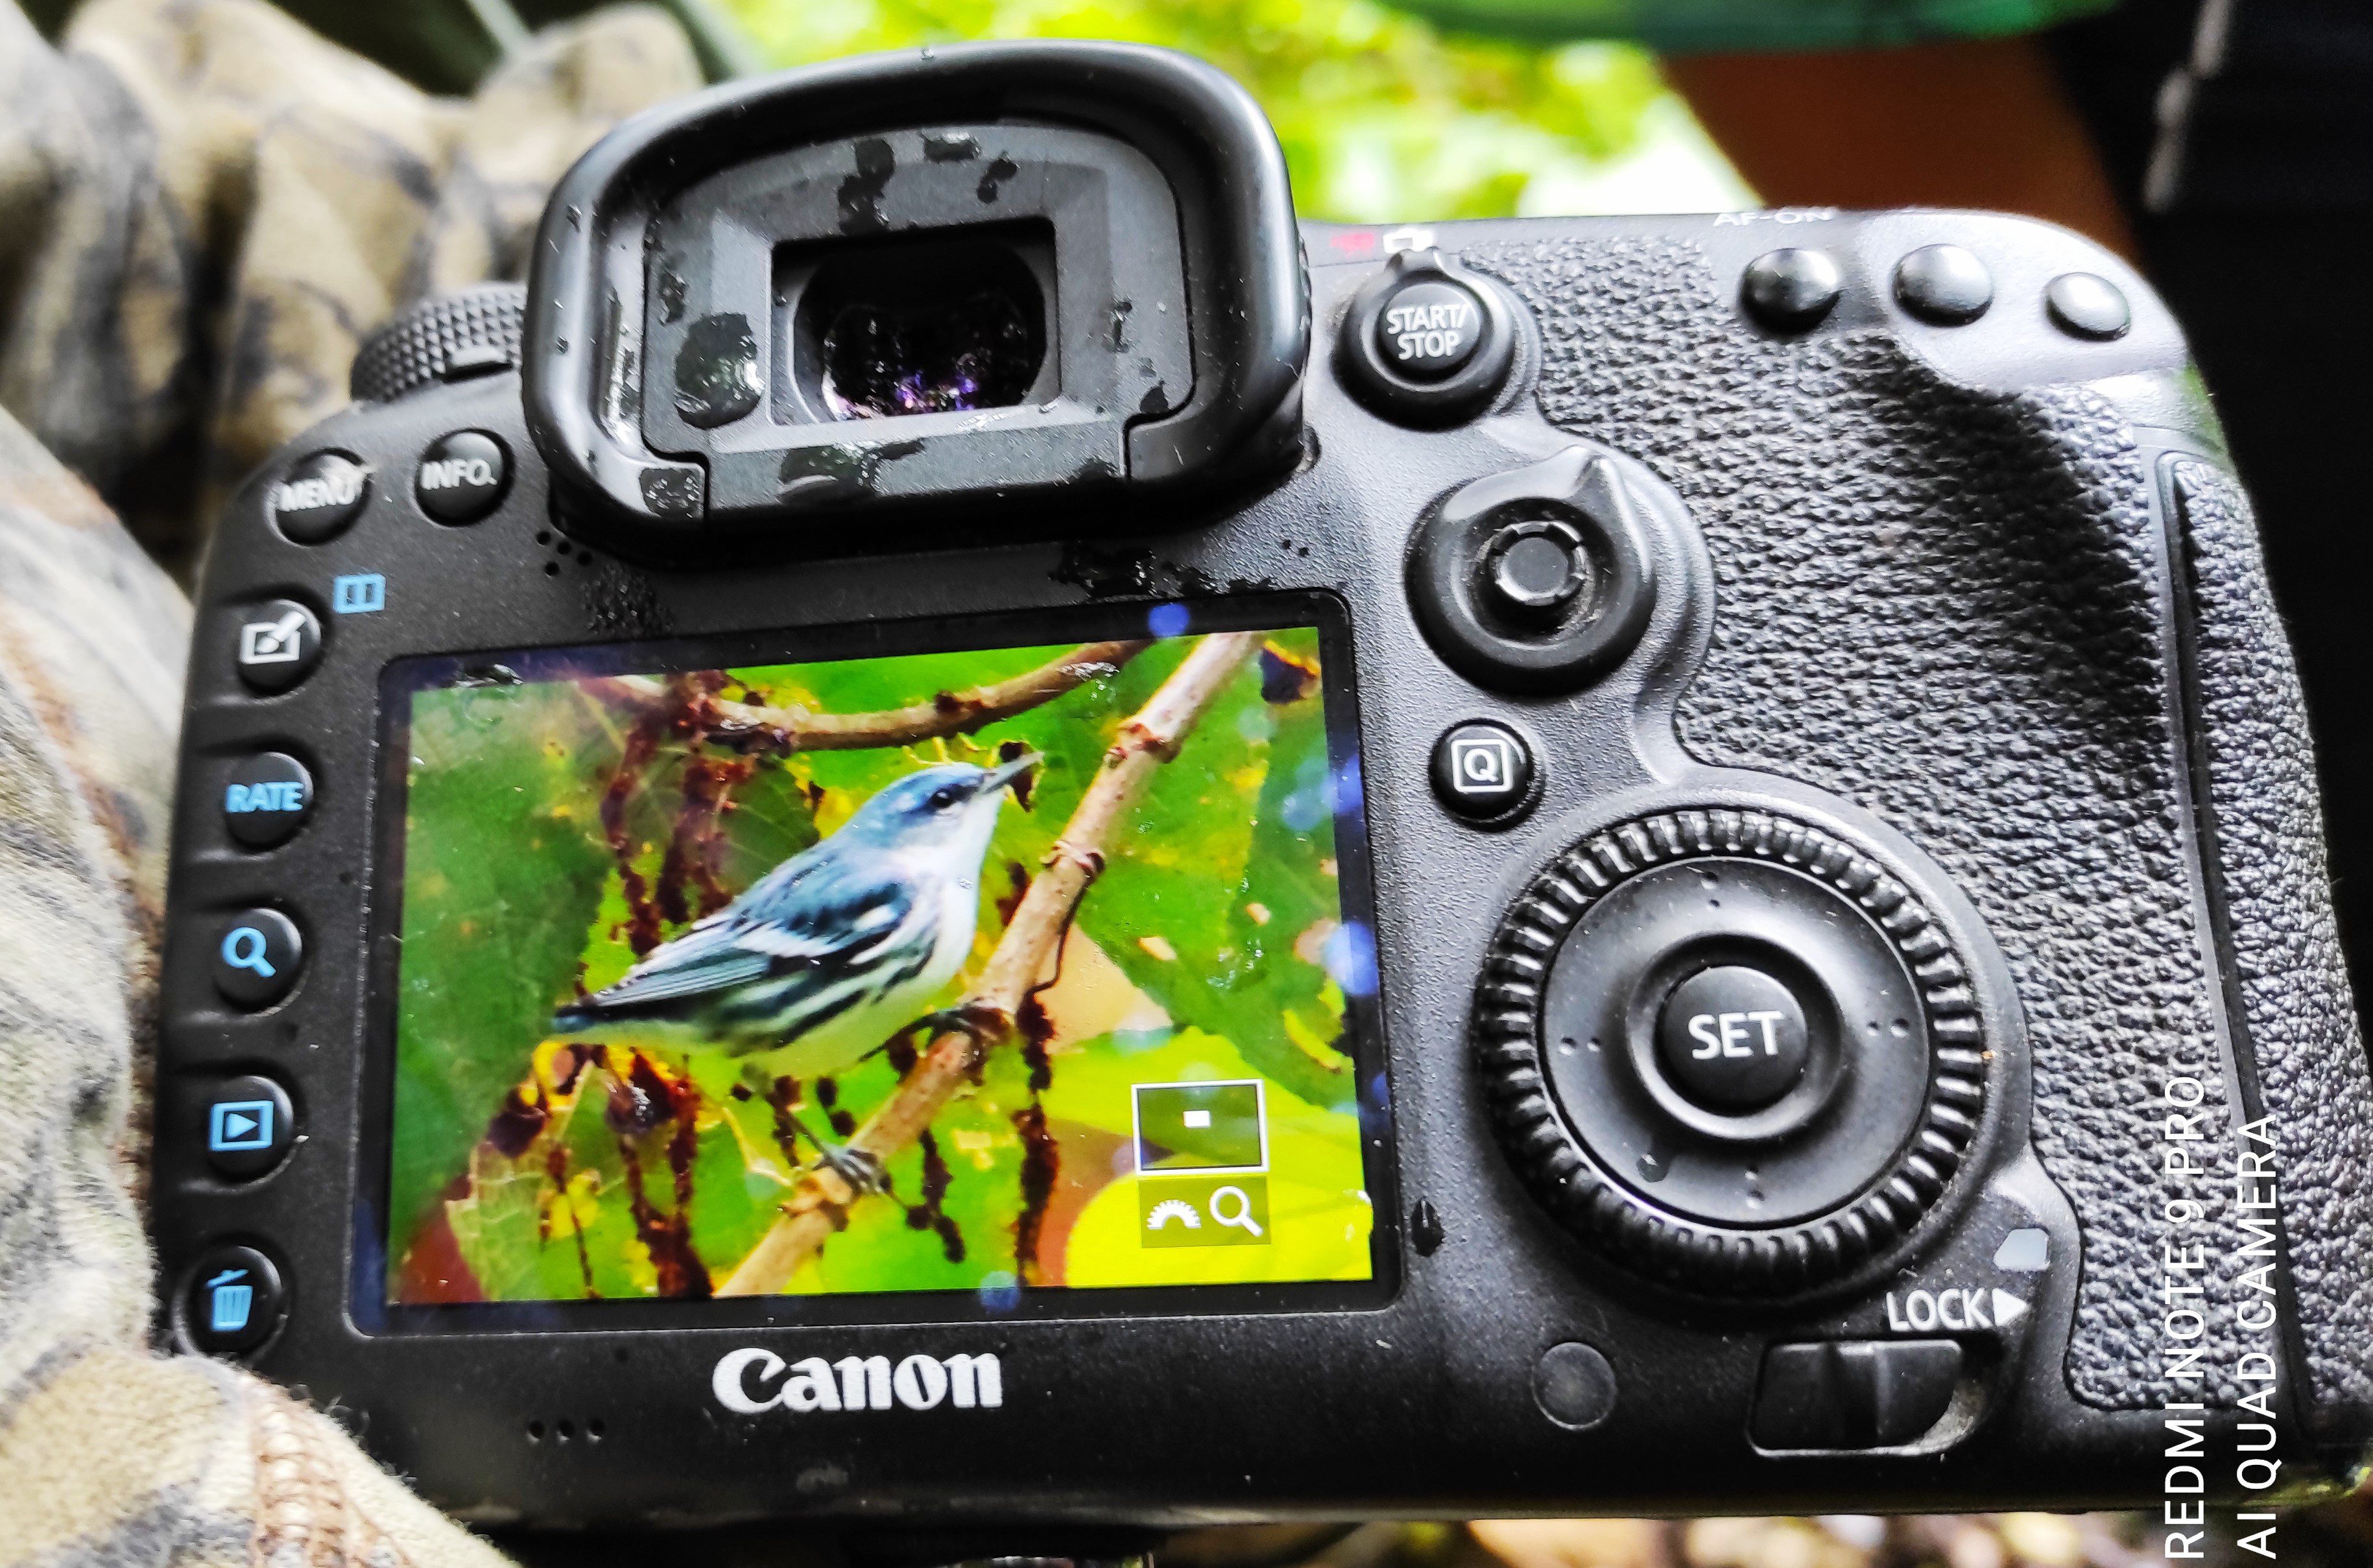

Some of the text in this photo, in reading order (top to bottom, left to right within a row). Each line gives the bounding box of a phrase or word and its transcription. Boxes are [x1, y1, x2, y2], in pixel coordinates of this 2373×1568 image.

[1385, 303, 1470, 335] START/
[1397, 329, 1461, 361] STOP
[420, 458, 498, 491] INFO.
[277, 473, 363, 512] MENU
[1463, 748, 1499, 783] Q
[224, 781, 304, 813] RATE
[1687, 1010, 1785, 1061] SET
[1885, 1287, 1994, 1333] LOCK
[712, 1347, 1003, 1414] Canon
